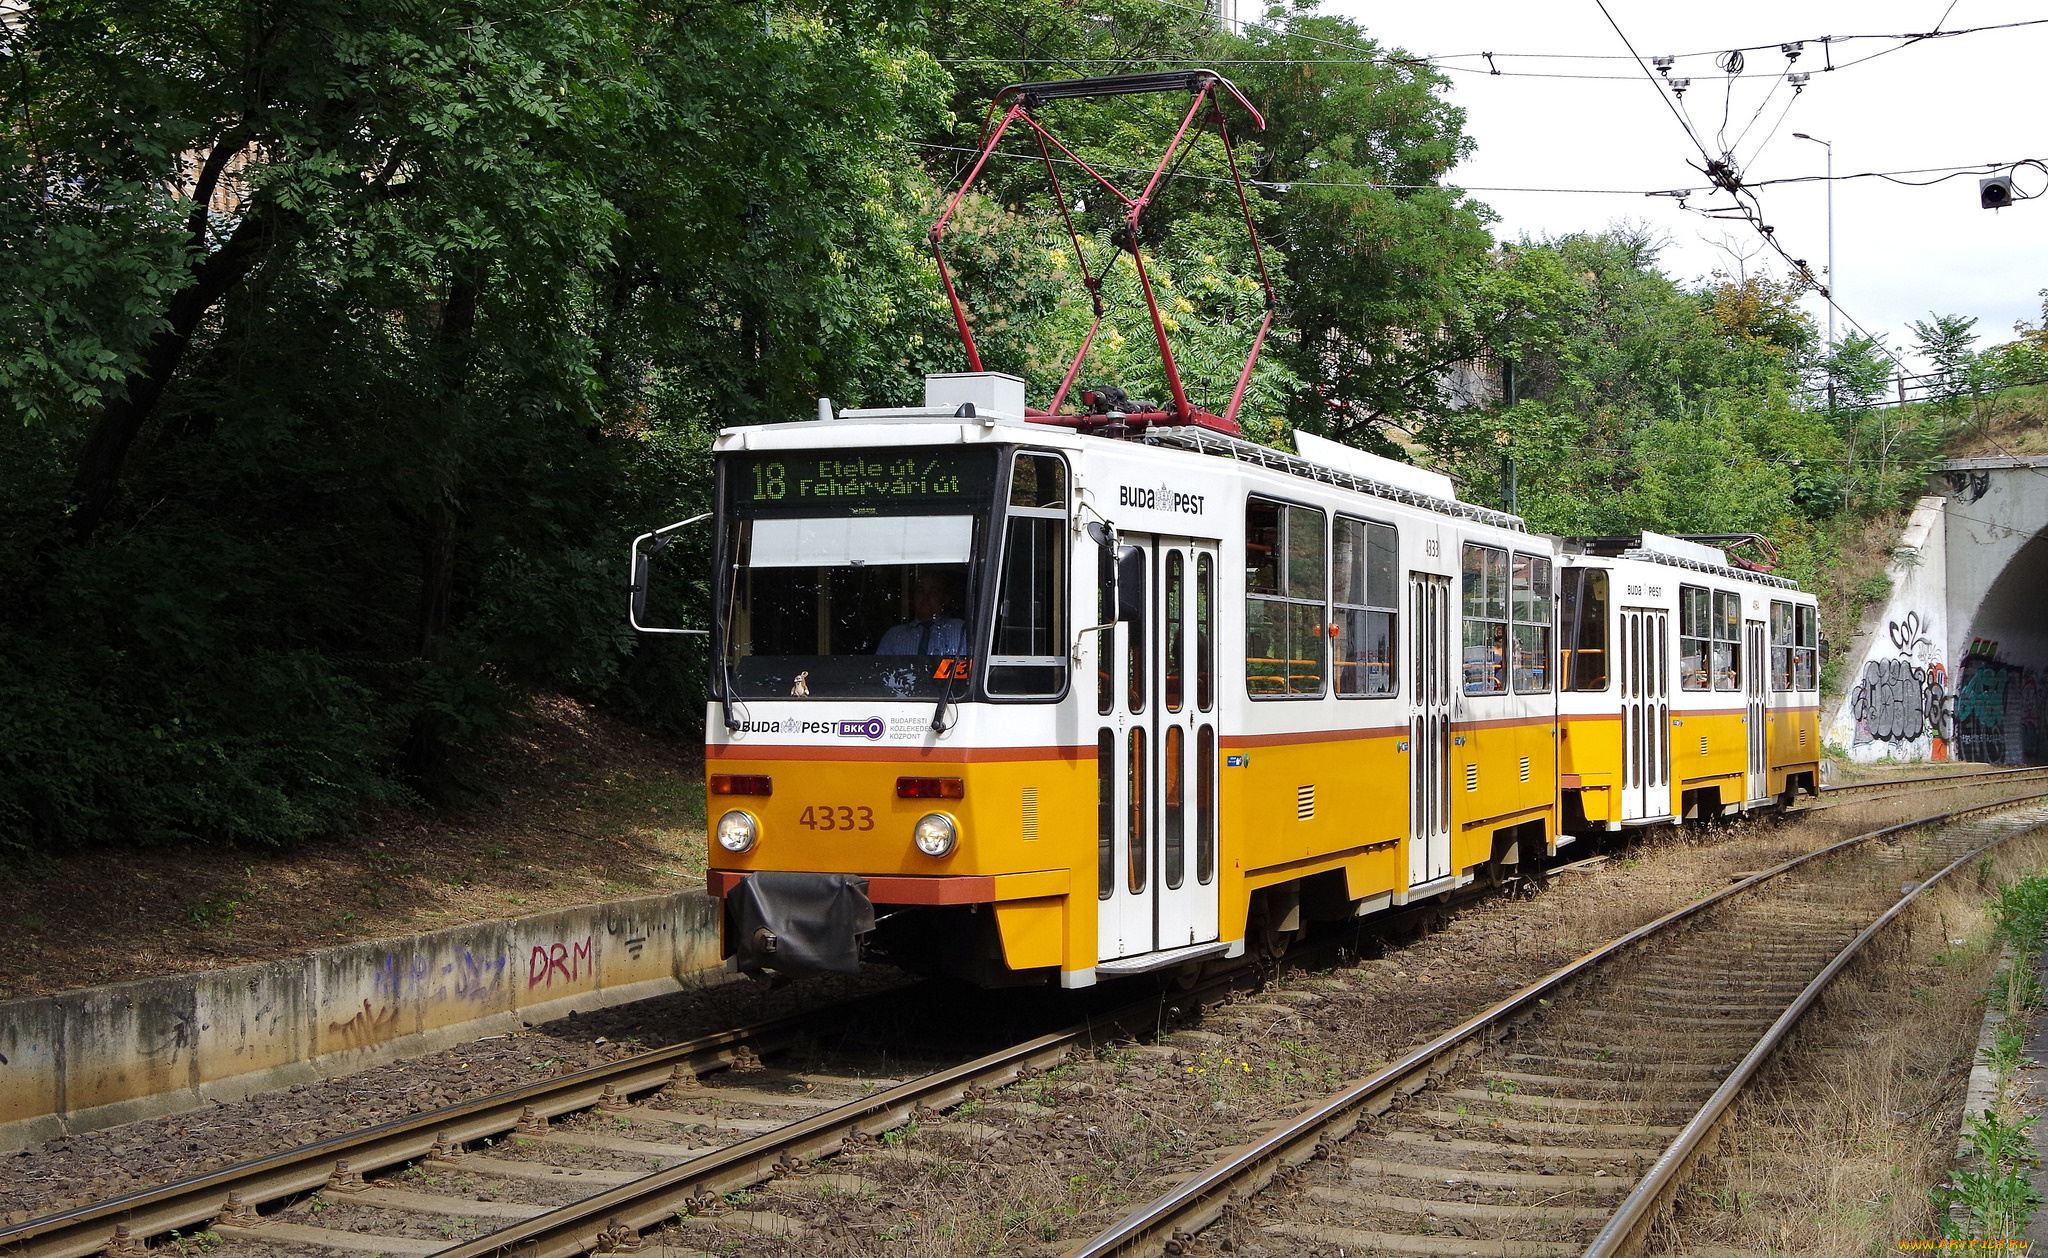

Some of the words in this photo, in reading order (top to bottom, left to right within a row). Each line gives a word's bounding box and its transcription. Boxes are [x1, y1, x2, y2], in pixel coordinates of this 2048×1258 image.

[819, 460, 883, 478] Etele
[889, 458, 916, 476] út
[753, 463, 786, 500] 18
[800, 476, 927, 497] Fehérvári
[933, 475, 960, 493] út
[1425, 539, 1440, 557] 4333
[843, 724, 865, 734] BKK
[799, 805, 875, 831] 4333
[528, 936, 593, 991] DRM
